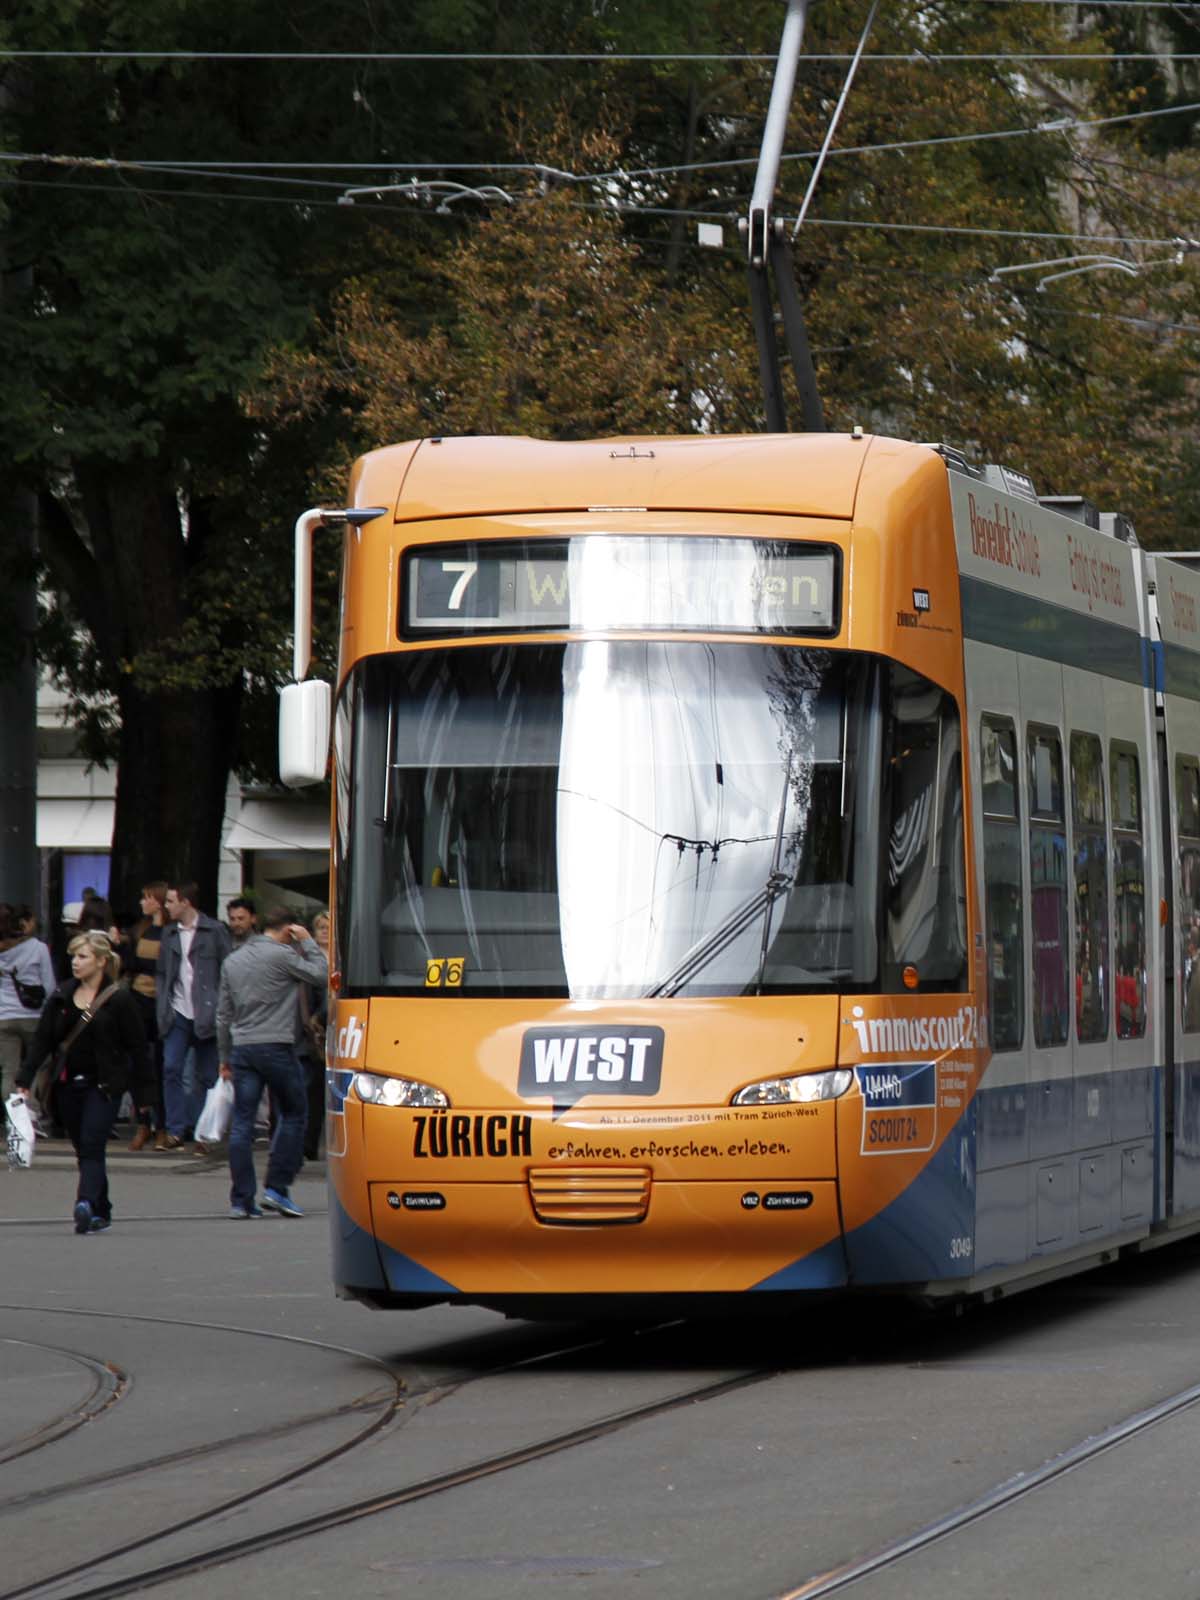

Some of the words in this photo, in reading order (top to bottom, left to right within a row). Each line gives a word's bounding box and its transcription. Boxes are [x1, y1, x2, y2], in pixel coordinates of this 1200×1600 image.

[441, 561, 477, 610] 7
[426, 963, 462, 984] 06
[534, 1037, 651, 1083] WEST
[687, 1113, 711, 1122] 2011
[715, 1112, 731, 1121] mit
[734, 1111, 759, 1121] Tram
[762, 1107, 819, 1120] Zürich-West
[413, 1109, 532, 1158] ZÜRICH
[548, 1143, 626, 1159] erfahren.
[630, 1140, 723, 1159] erforschen.
[727, 1138, 791, 1157] erleben.
[950, 1238, 971, 1258] 3049
